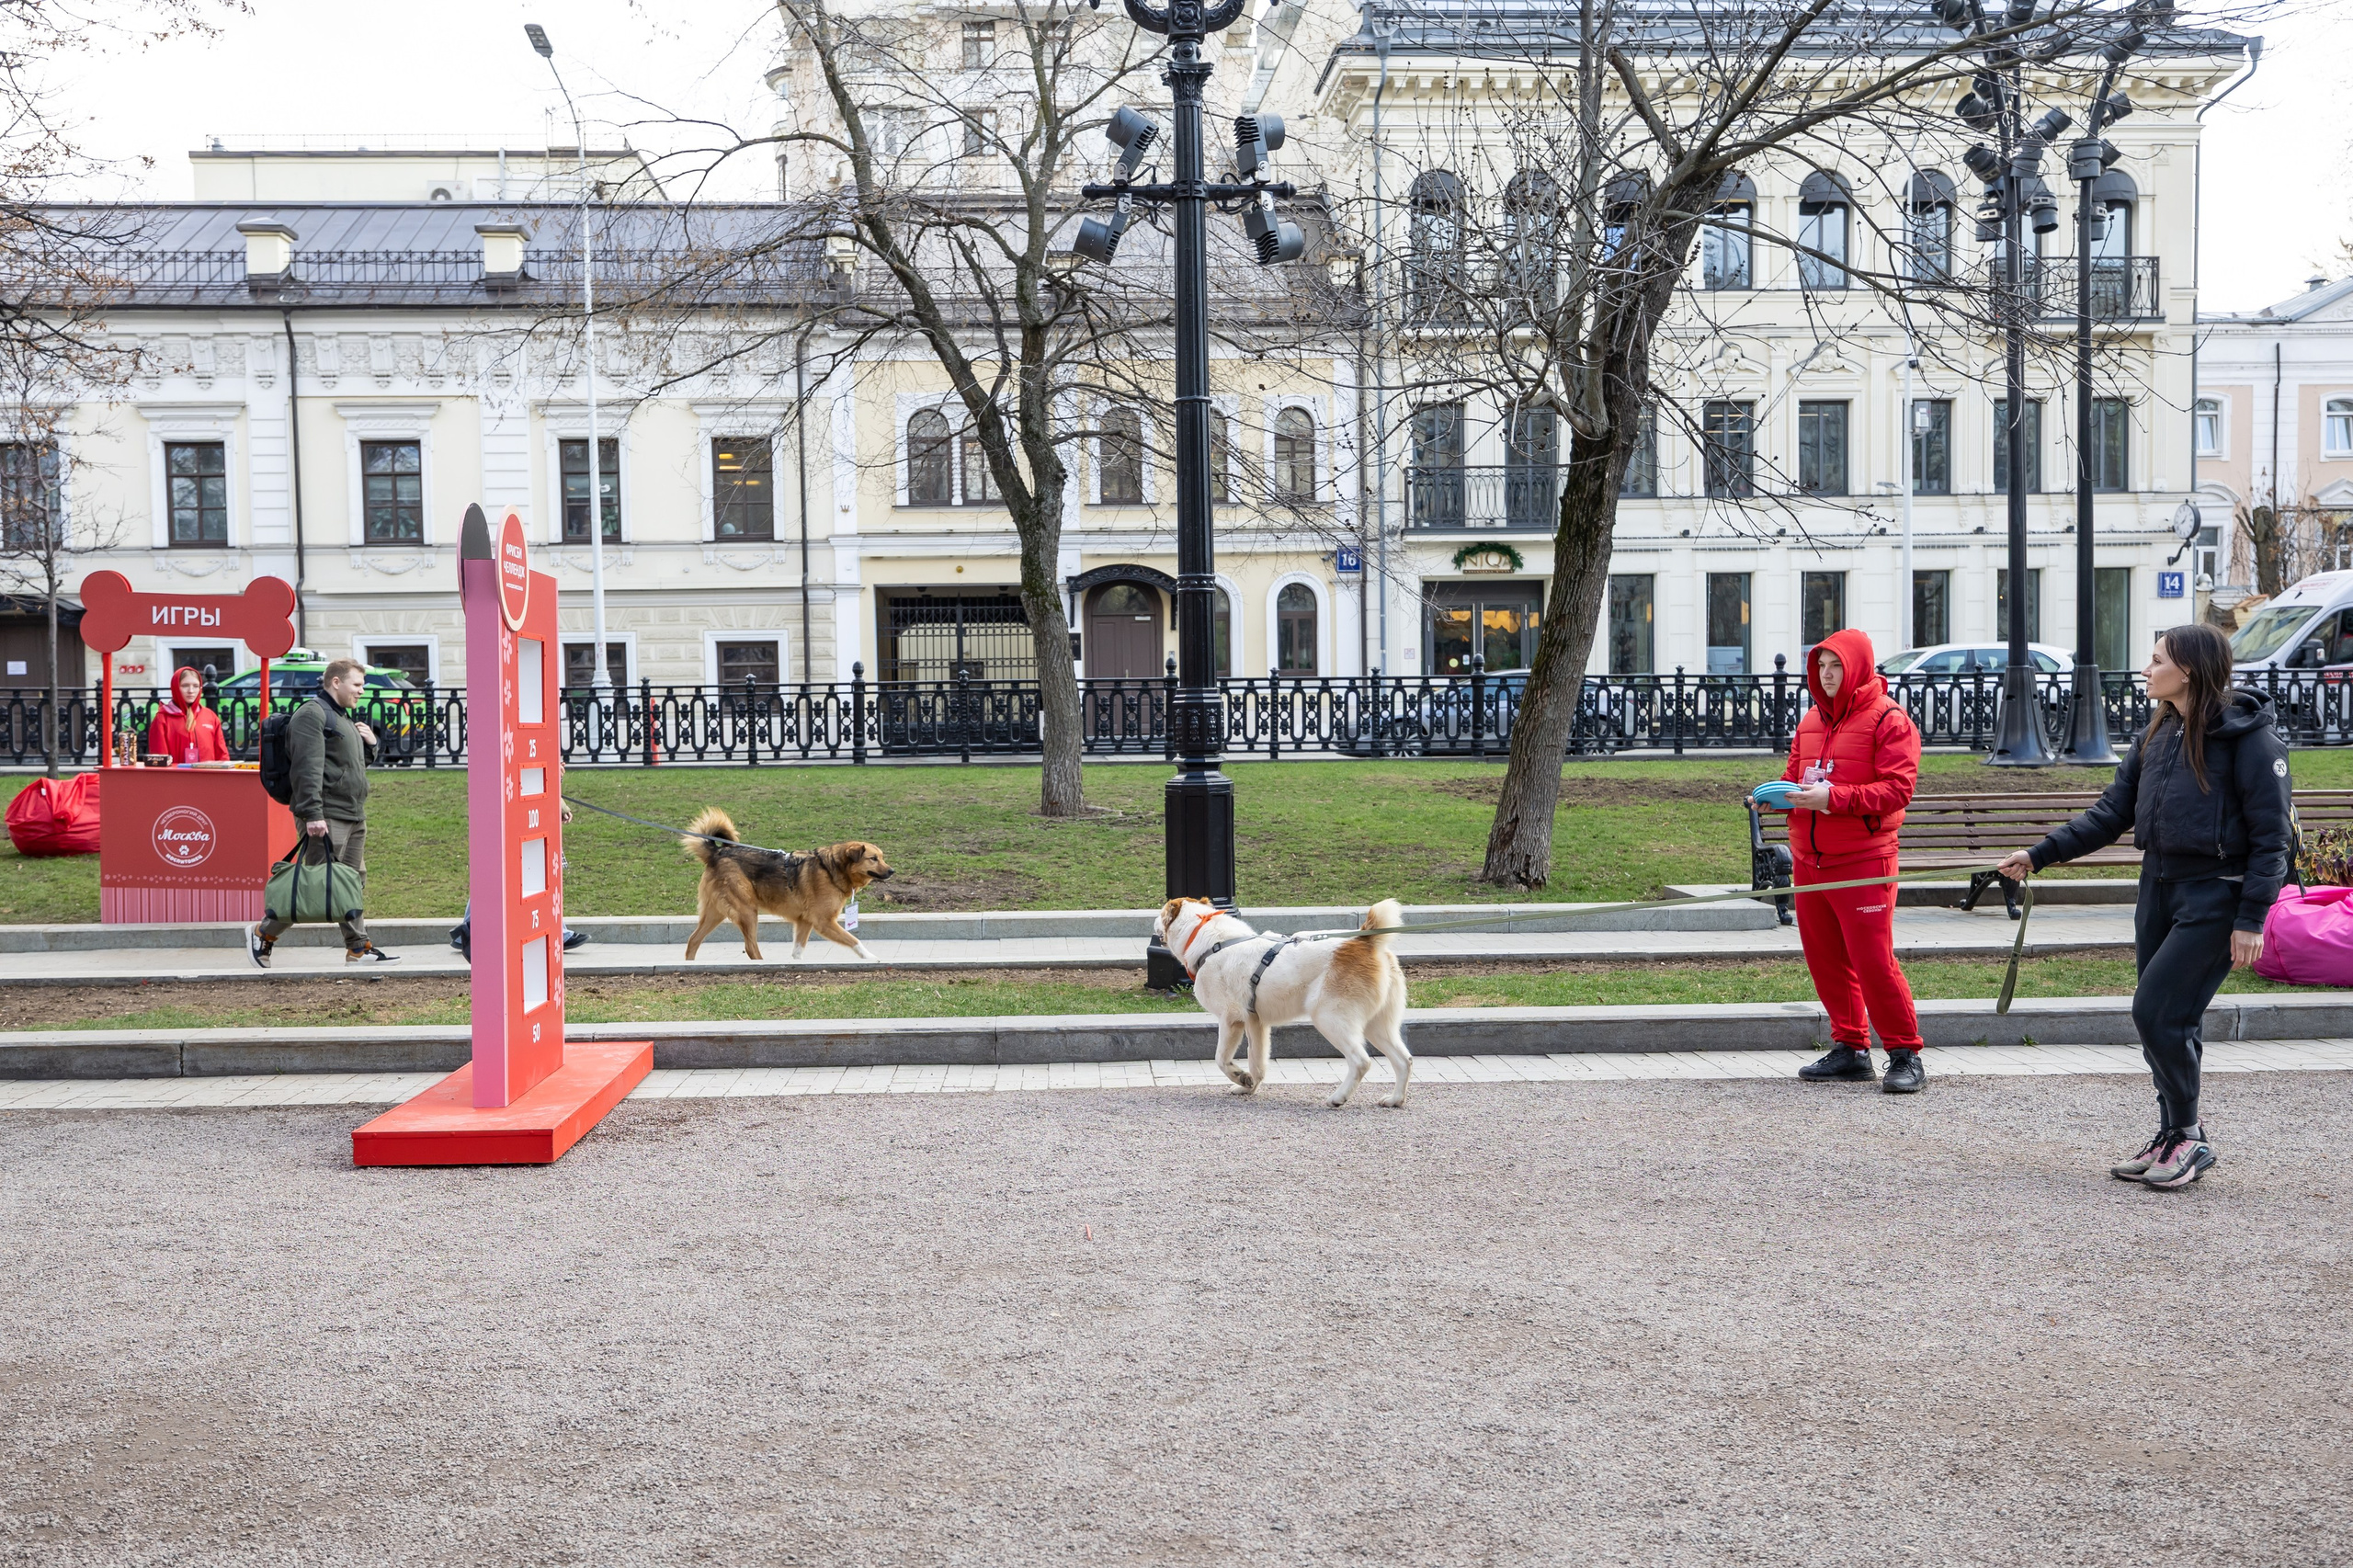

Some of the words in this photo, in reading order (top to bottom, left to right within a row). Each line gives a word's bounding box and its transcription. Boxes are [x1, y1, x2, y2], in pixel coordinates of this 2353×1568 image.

[506, 542, 522, 560] ФРИСБИ
[1341, 553, 1357, 566] 16
[503, 560, 525, 580] ЧЕЛЛЕНДЖ
[2164, 575, 2180, 589] 14
[152, 605, 221, 627] ИГРЫ
[529, 738, 537, 758] 25
[529, 809, 540, 828] 100
[157, 829, 210, 841] Москва
[531, 909, 540, 929] 75
[532, 1022, 540, 1044] 50
